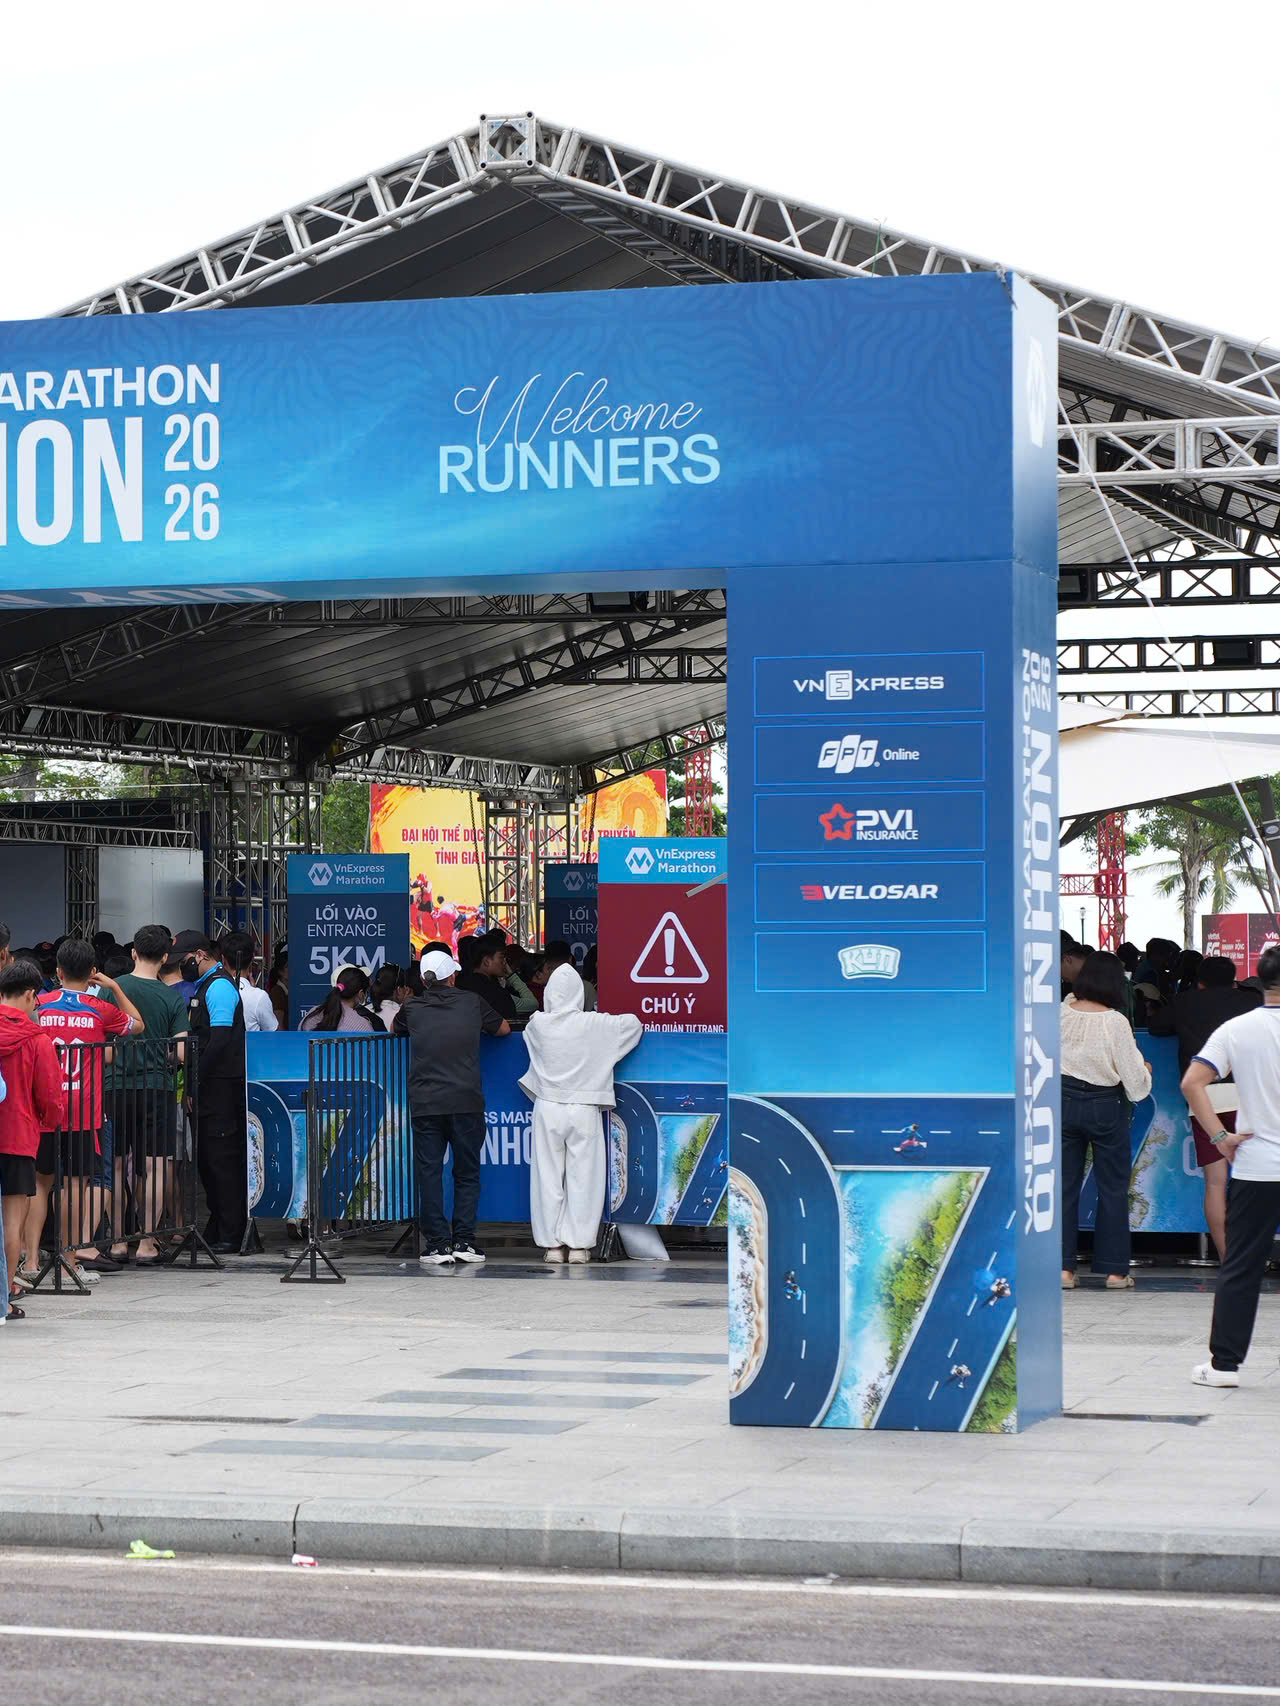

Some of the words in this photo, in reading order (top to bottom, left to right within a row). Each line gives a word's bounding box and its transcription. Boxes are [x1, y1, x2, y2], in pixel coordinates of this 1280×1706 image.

[455, 372, 702, 452] Welcome
[164, 413, 219, 471] 20
[439, 433, 720, 493] RUNNERS
[164, 482, 219, 541] 26
[793, 670, 944, 700] VNEXPRESS
[1031, 652, 1041, 709] 20
[1040, 656, 1051, 713] 26
[817, 735, 878, 774] FPT
[883, 748, 920, 761] Online
[1022, 648, 1033, 930] MARATHON
[856, 810, 913, 830] PVI
[402, 829, 419, 844] ĐẠI
[422, 827, 439, 844] HỘI
[442, 824, 460, 842] THỂ
[856, 830, 919, 841] INSURANCE
[435, 847, 458, 864] TỈNH
[656, 848, 716, 861] VnExpress
[334, 863, 385, 873] VnExpress
[658, 863, 716, 873] Marathon
[1031, 729, 1053, 1003] NHON
[336, 875, 385, 885] Marathon
[822, 884, 939, 899] VELOSAR
[315, 903, 339, 920] LỐI
[344, 906, 377, 920] VÀO
[570, 905, 589, 920] LỐI
[308, 924, 386, 937] ENTRANCE
[563, 923, 598, 934] ENTRA
[309, 946, 385, 975] 5KM
[641, 993, 679, 1014] CHÚ
[683, 993, 696, 1014] Ý
[40, 1015, 65, 1027] GDTC
[68, 1016, 94, 1028] K49A
[1024, 942, 1033, 1235] VNEXPRESS
[1032, 1035, 1055, 1233] QUY
